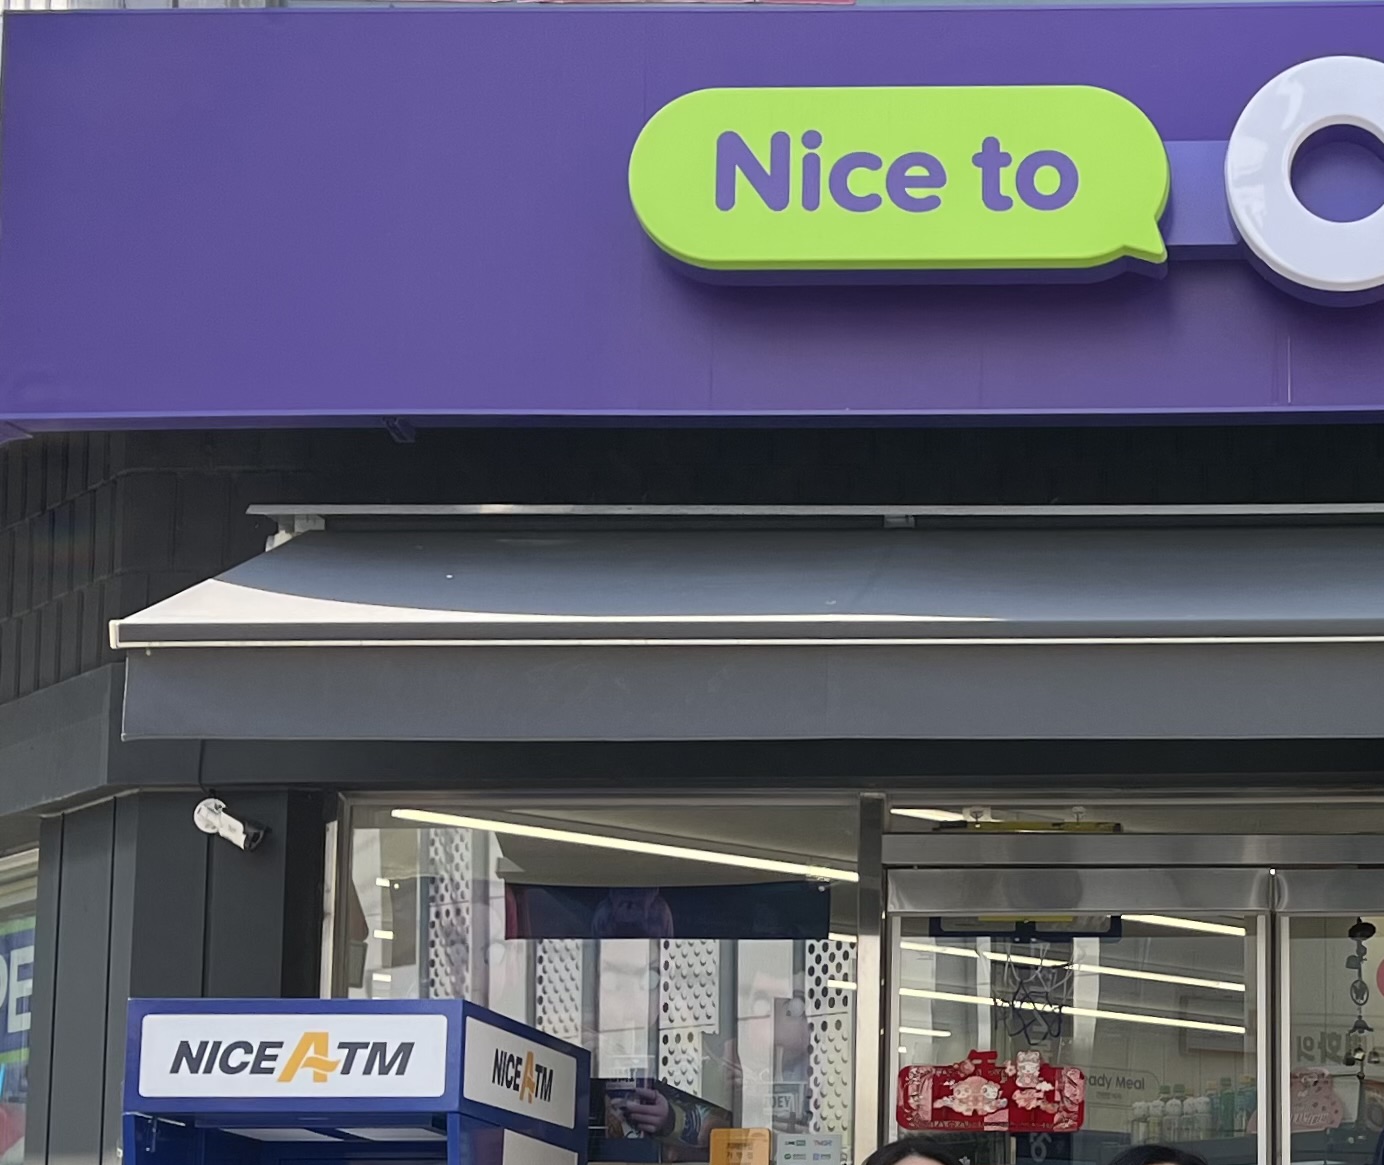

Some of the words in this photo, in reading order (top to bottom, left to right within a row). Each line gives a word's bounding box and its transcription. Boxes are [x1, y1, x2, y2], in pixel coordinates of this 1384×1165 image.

[714, 129, 948, 214] Nice
[971, 135, 1080, 214] to
[1086, 1073, 1112, 1089] ady
[1115, 1076, 1145, 1090] Meal
